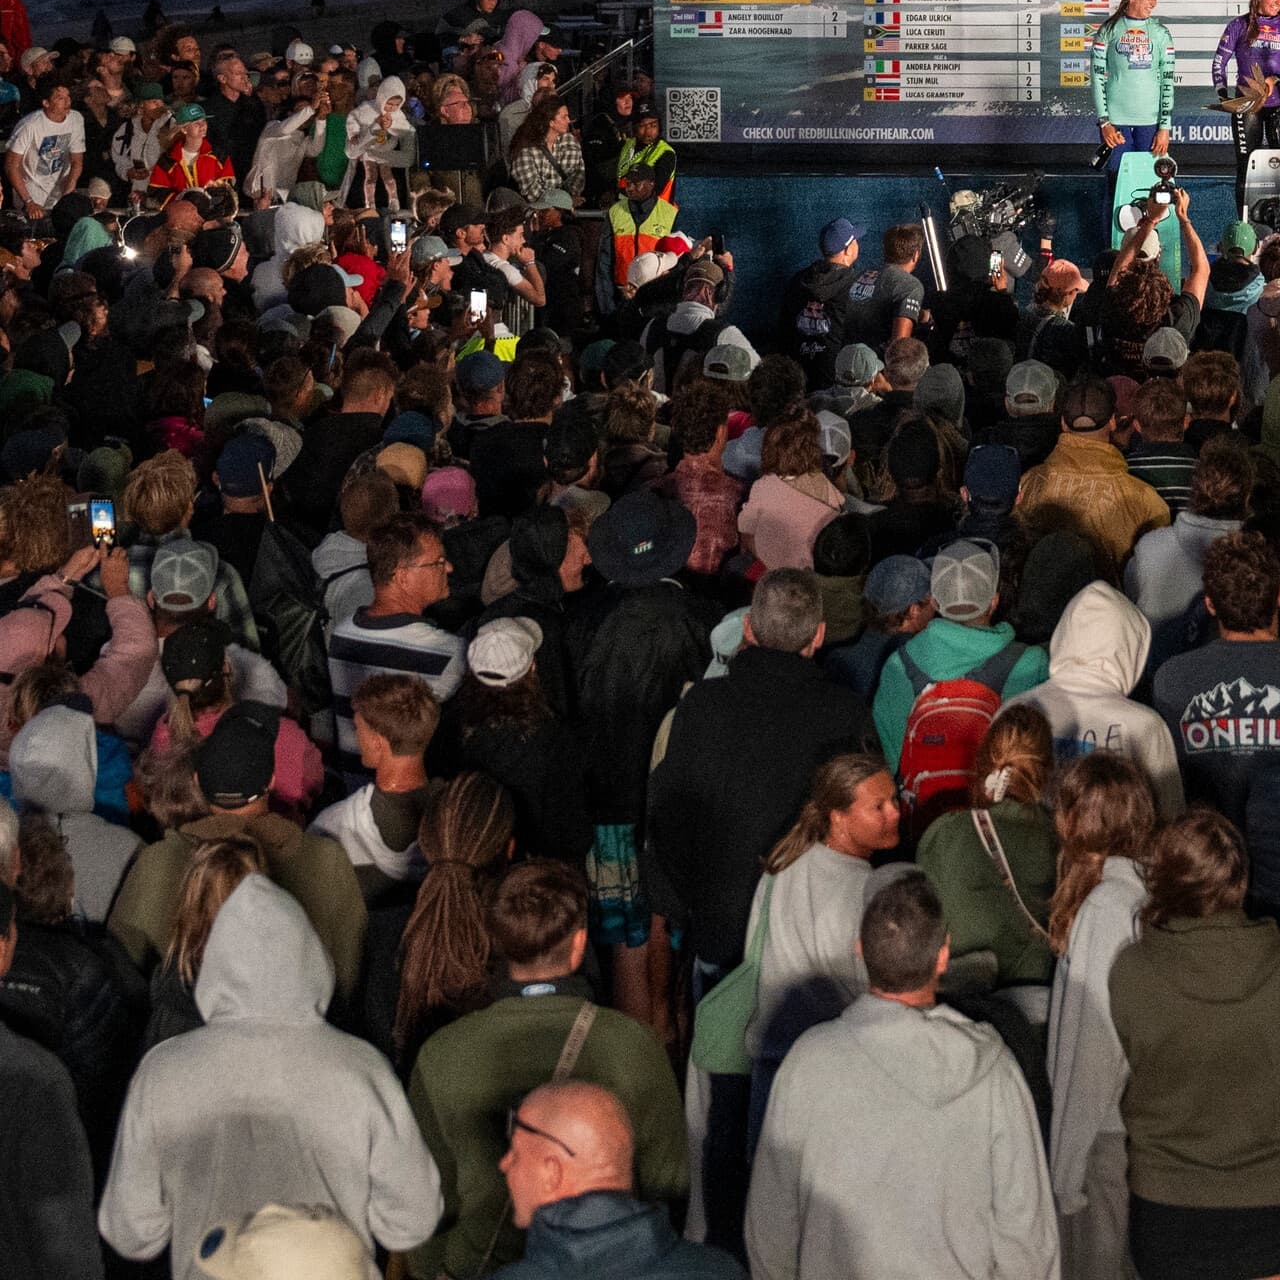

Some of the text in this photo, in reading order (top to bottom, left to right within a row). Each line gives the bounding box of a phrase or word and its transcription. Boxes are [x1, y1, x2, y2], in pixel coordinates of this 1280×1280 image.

[1160, 84, 1171, 125] NORTH
[743, 128, 934, 139] CHECK OUT REDBULLKINGOFTHEAIR.COM
[1237, 113, 1247, 153] MYSTIC
